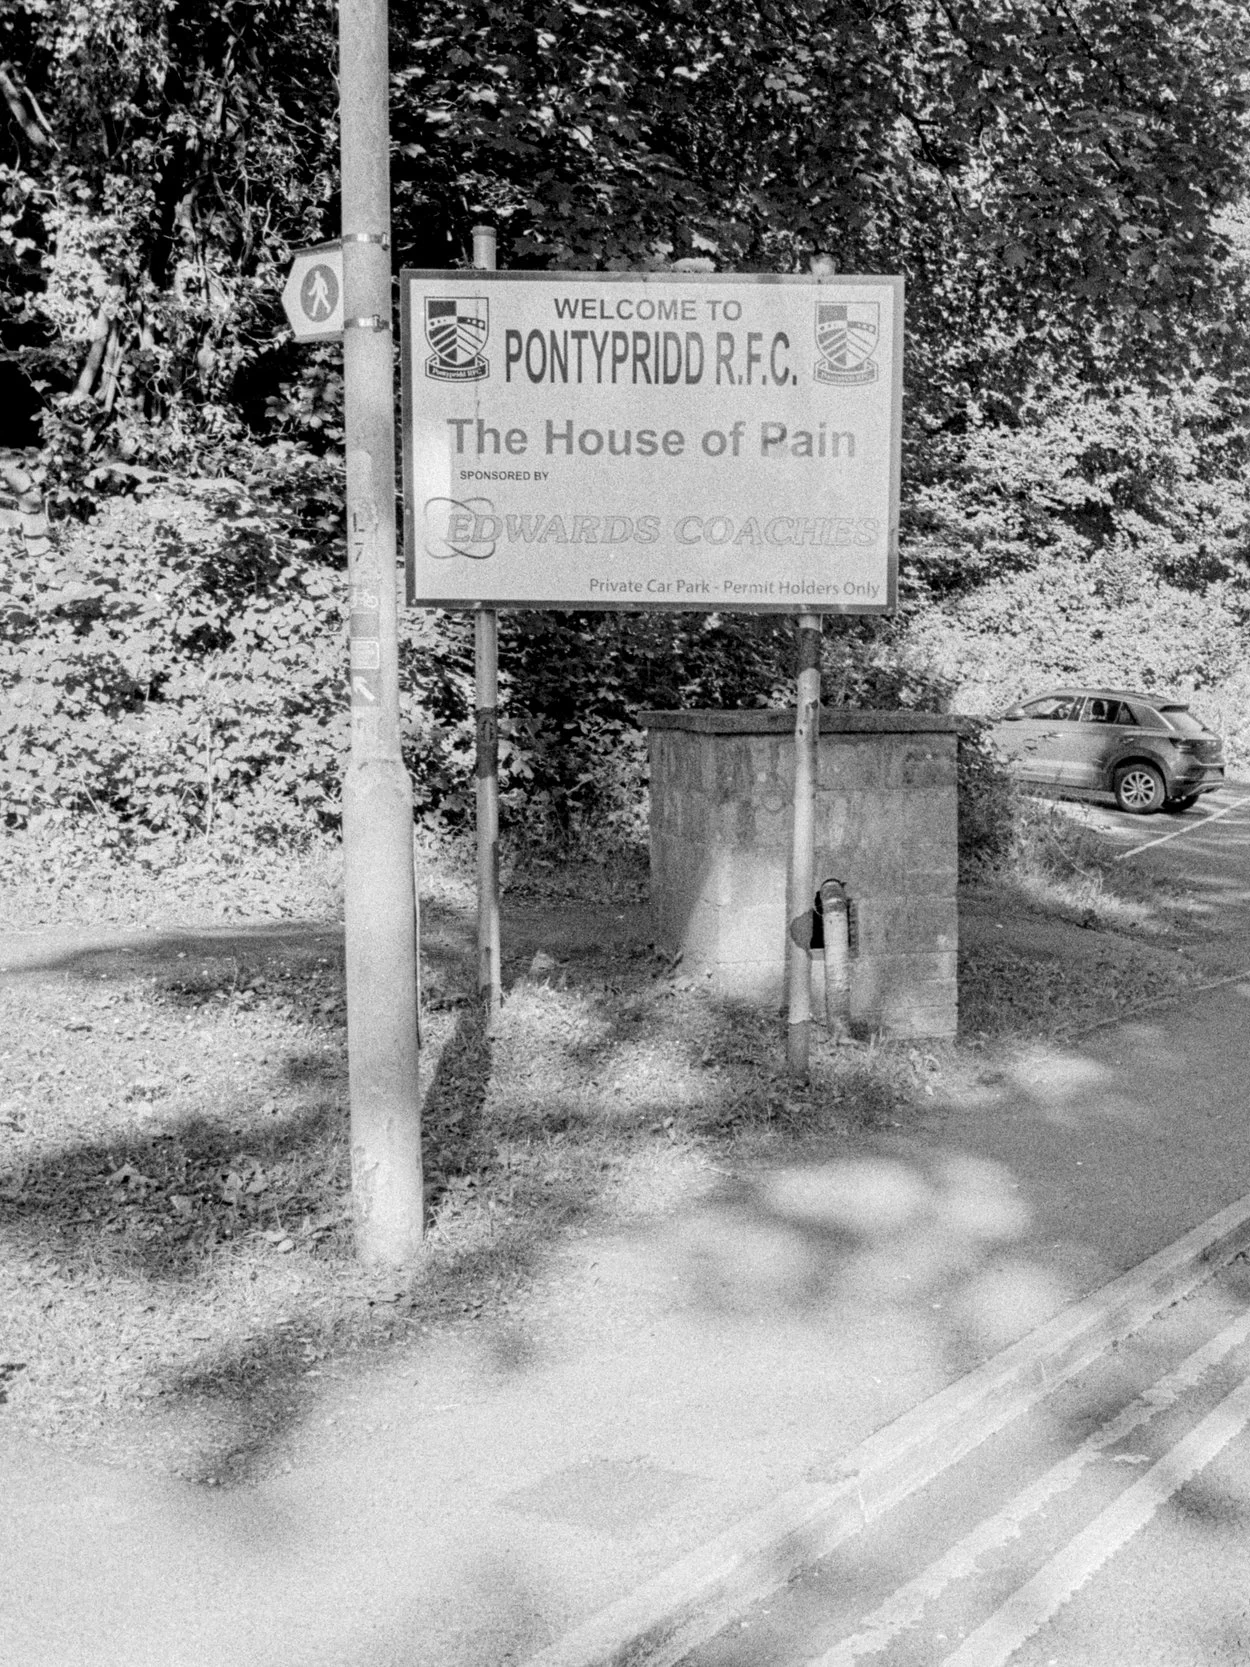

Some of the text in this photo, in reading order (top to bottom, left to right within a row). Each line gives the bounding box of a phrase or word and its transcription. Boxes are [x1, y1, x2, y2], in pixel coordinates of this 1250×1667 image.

[554, 298, 743, 321] WELCOME TO
[505, 328, 798, 387] PONTYPRIDD R.F.C.
[446, 418, 856, 458] The House of Pain
[459, 470, 550, 481] SPONSORED BY
[447, 513, 880, 547] EDWARDS COACHES
[589, 578, 643, 593] Private
[647, 579, 672, 593] Car
[676, 579, 711, 593] Park
[723, 580, 774, 595] Permit
[778, 580, 840, 596] Holders
[843, 582, 880, 599] Only
